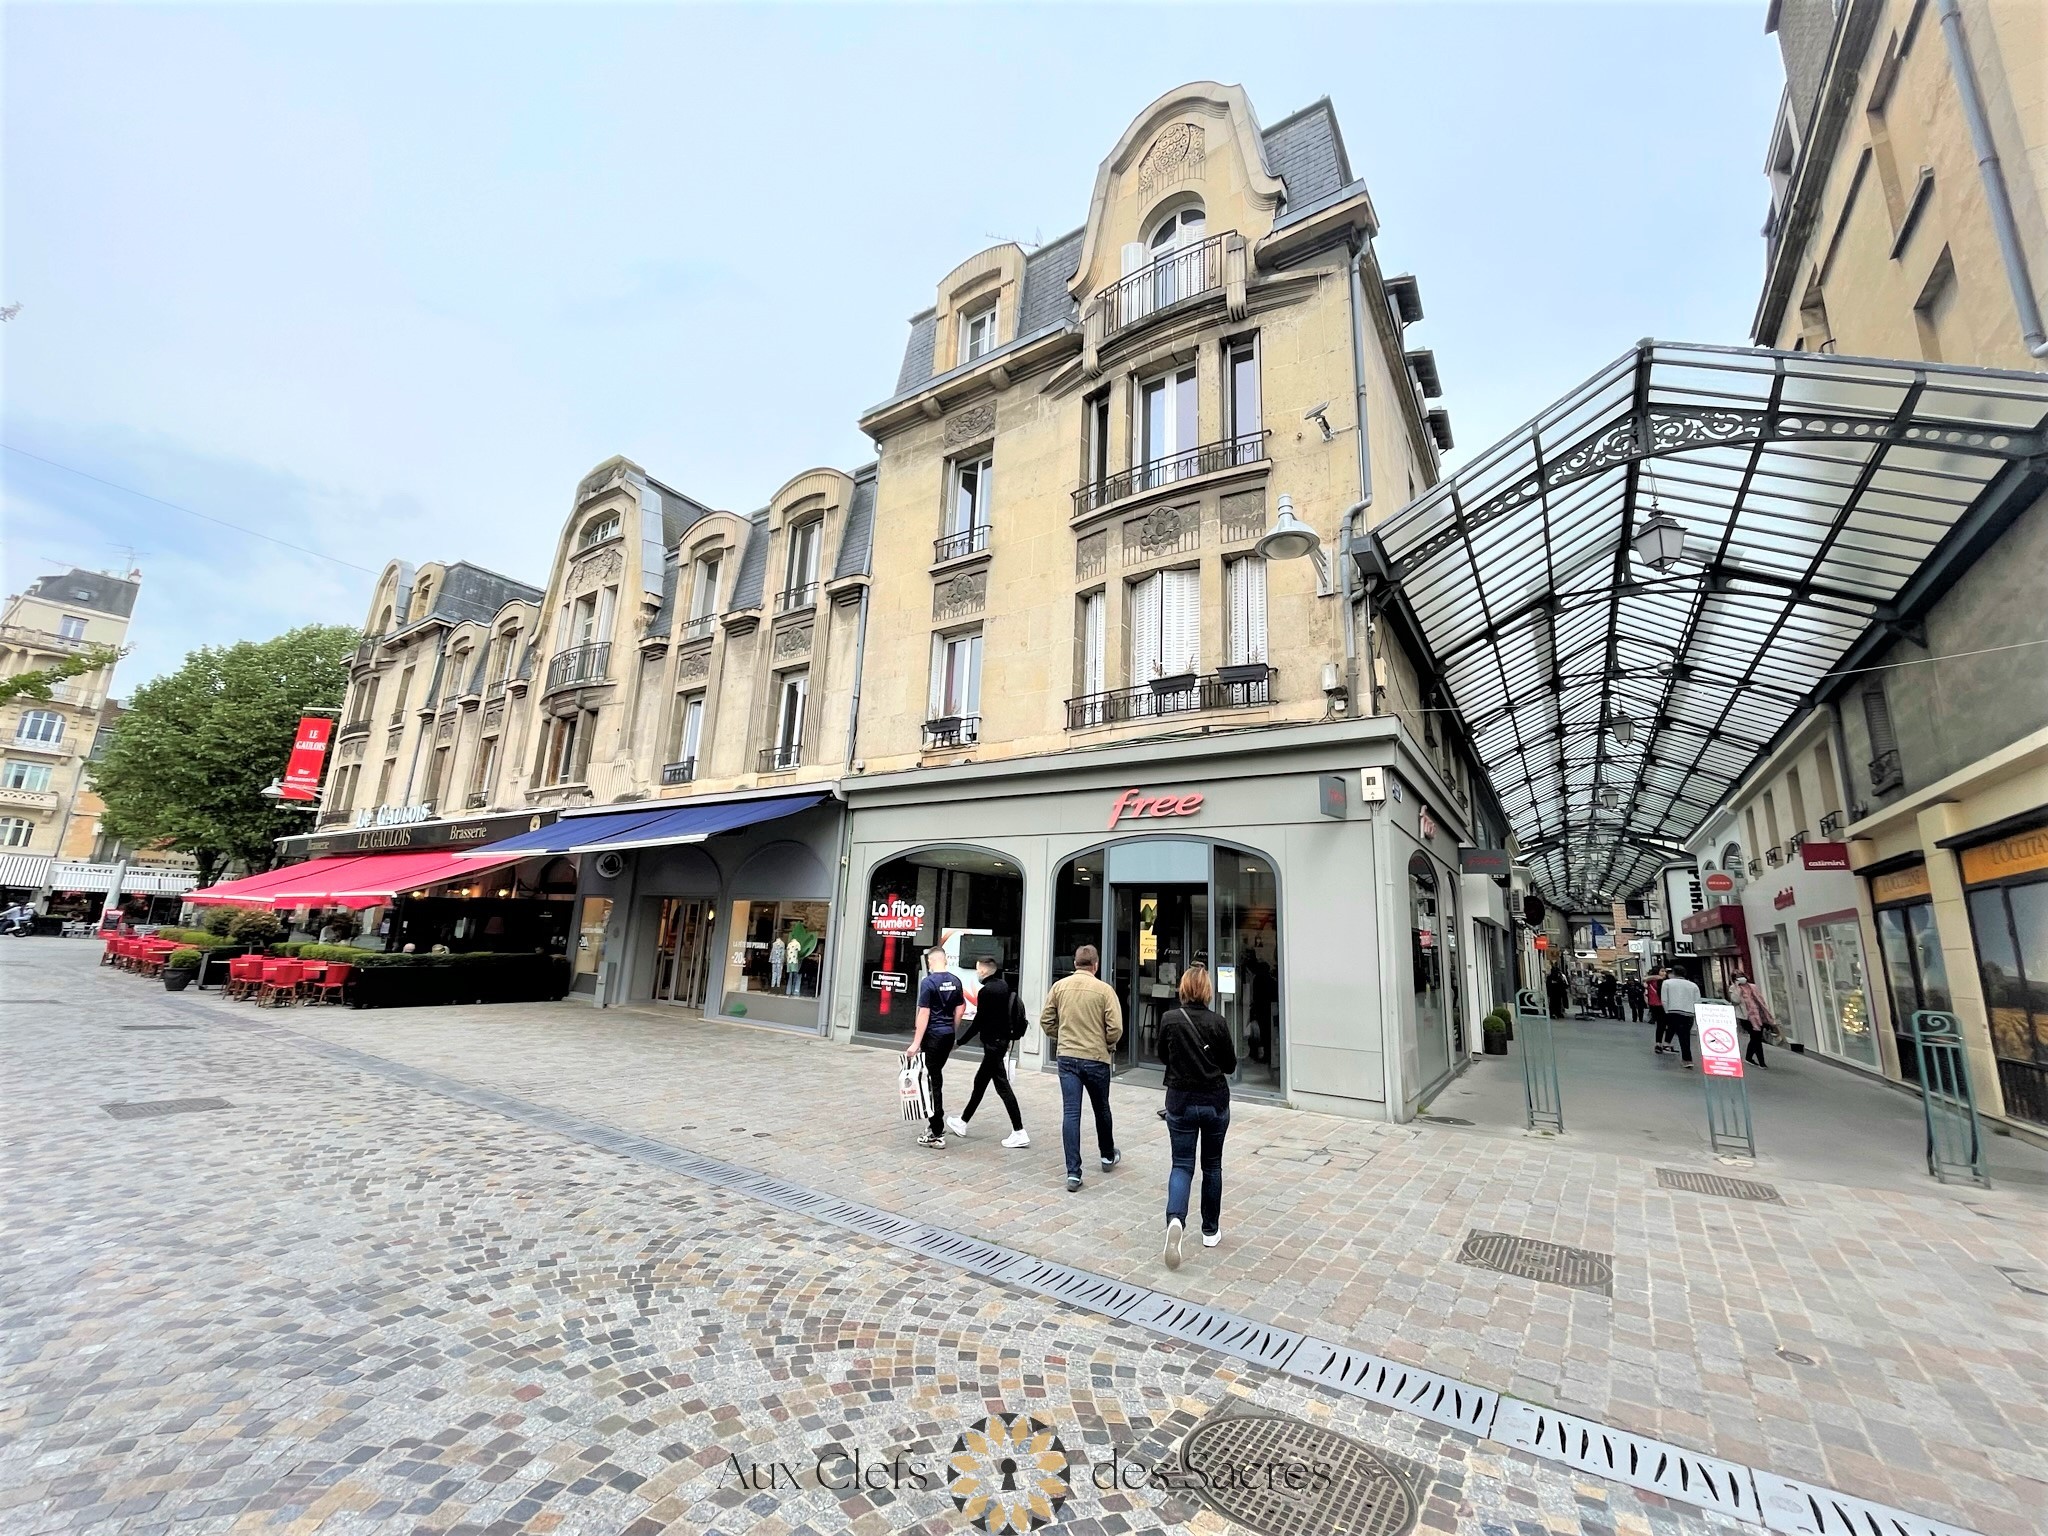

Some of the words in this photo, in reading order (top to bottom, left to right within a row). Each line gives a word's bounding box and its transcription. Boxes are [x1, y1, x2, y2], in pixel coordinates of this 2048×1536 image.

[308, 729, 319, 739] LE
[295, 741, 326, 751] GAULOIS
[1108, 788, 1204, 831] free
[450, 822, 487, 841] Brasserie
[357, 832, 371, 849] LE
[370, 827, 412, 848] GAULOIS
[1808, 859, 1846, 867] catimini
[63, 866, 114, 874] BOULANGER
[871, 900, 888, 916] La
[891, 899, 925, 918] fibre
[876, 917, 912, 929] numéro
[1676, 942, 1697, 954] SH
